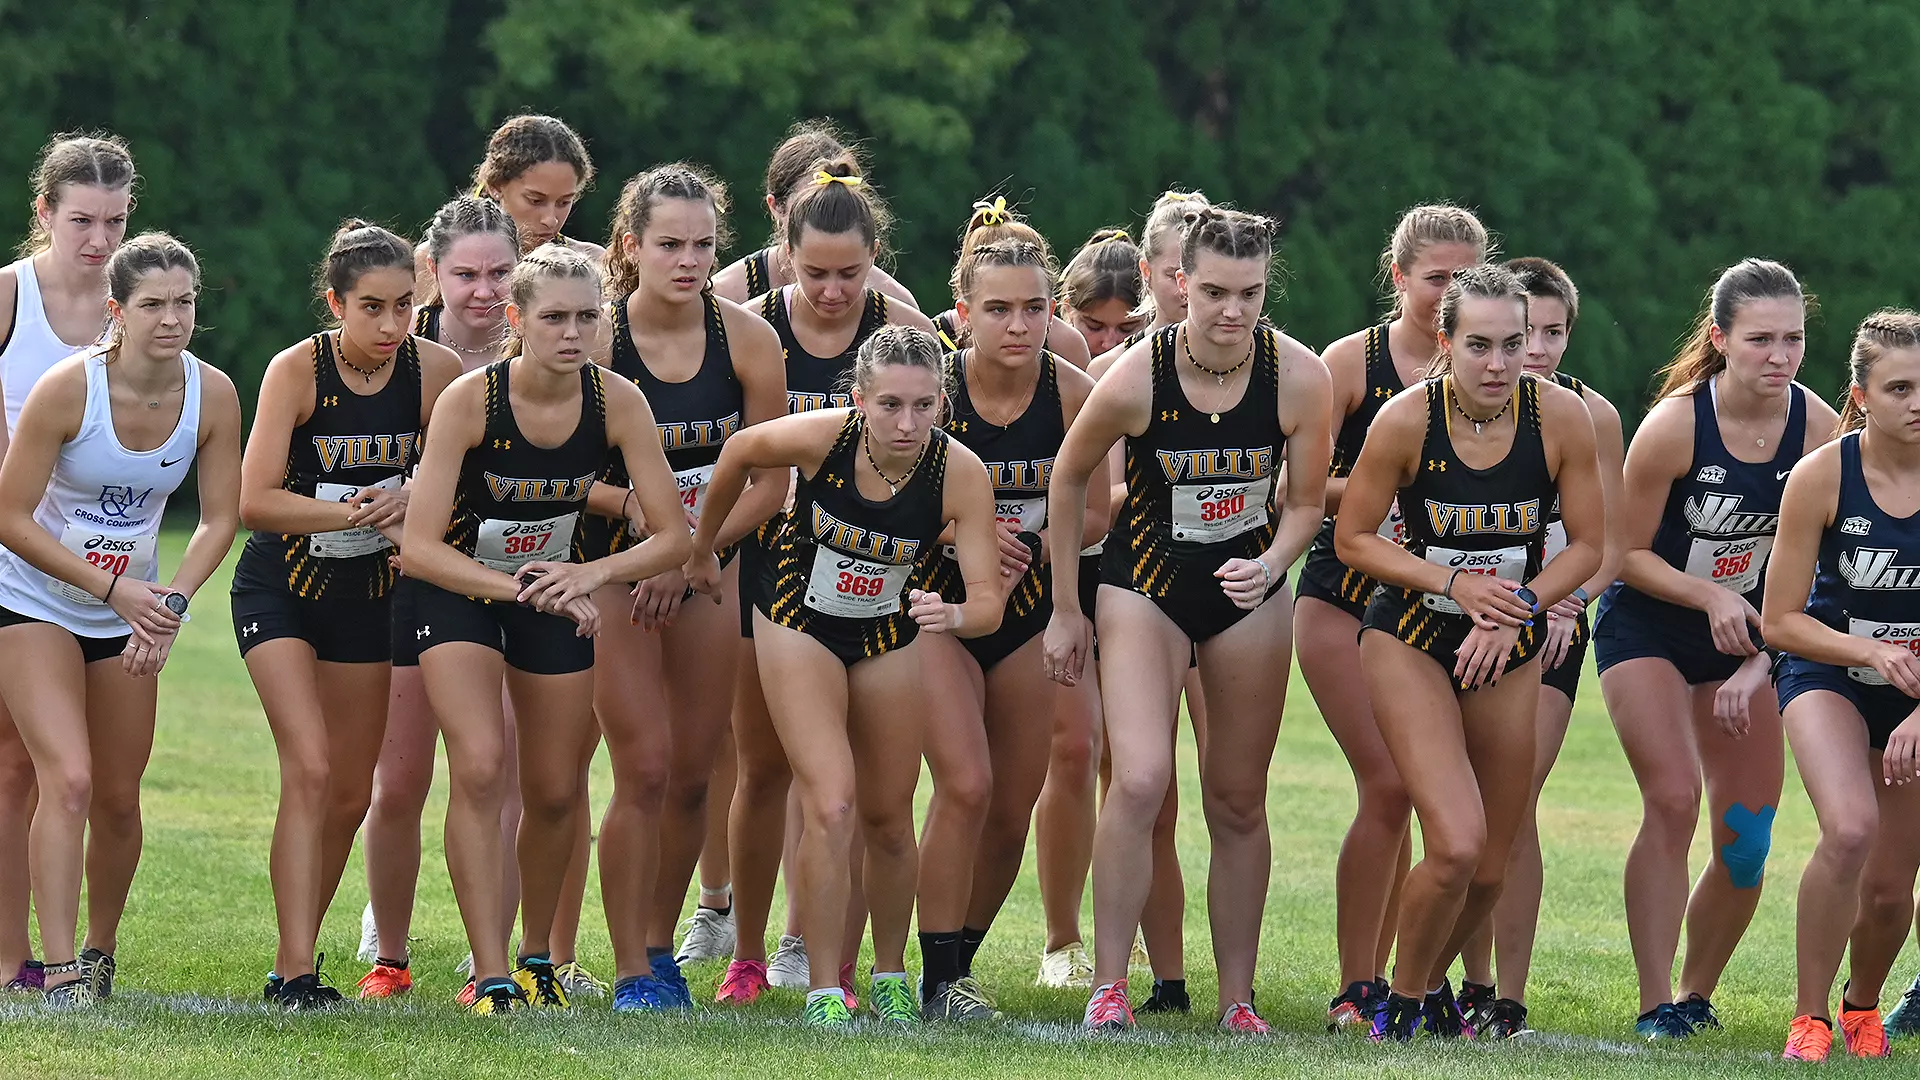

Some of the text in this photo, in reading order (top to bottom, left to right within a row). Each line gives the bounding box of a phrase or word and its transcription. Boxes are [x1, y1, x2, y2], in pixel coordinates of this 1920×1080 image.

[656, 411, 739, 451] ILLE
[312, 432, 415, 473] VILLE
[1156, 446, 1273, 483] VILLE
[483, 470, 597, 502] VILLE
[1699, 472, 1723, 482] MAC
[1213, 486, 1249, 499] asics
[74, 508, 146, 528] CROSS COUNTRY
[1200, 494, 1245, 522] 380
[1424, 498, 1541, 537] VILLE
[519, 521, 556, 534] asics
[811, 500, 920, 566] VILLE
[1843, 523, 1868, 533] MAC
[101, 539, 137, 552] asics
[504, 531, 553, 555] 367
[853, 562, 890, 576] asics
[1466, 553, 1504, 566] asics
[1711, 551, 1753, 579] 358
[836, 571, 885, 597] 369
[1889, 626, 1920, 638] asic
